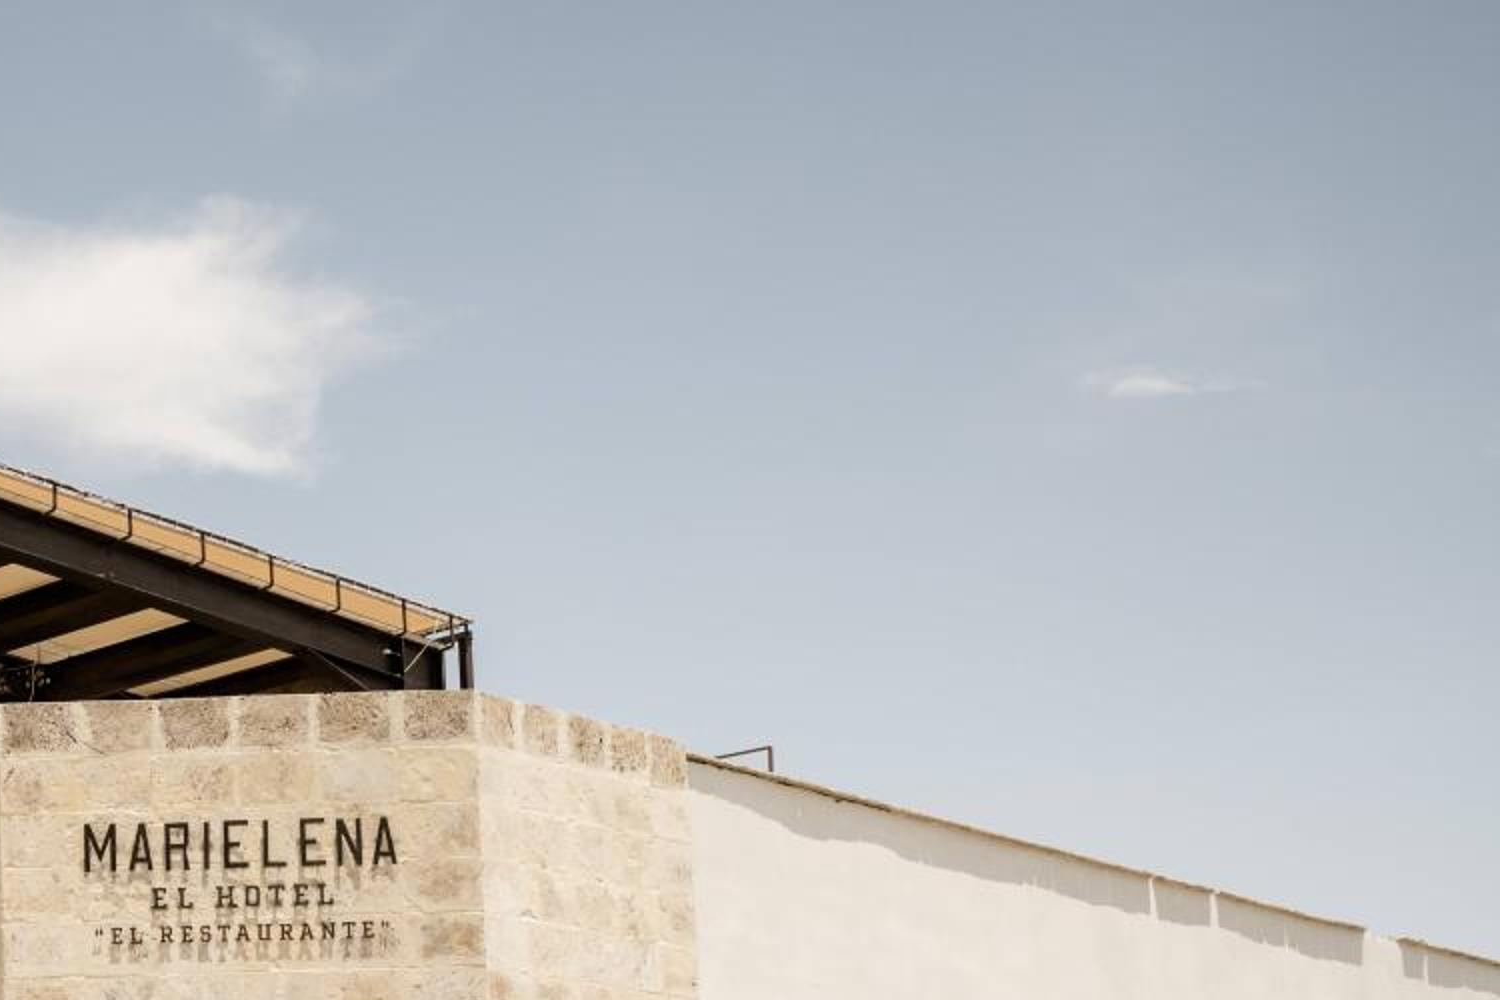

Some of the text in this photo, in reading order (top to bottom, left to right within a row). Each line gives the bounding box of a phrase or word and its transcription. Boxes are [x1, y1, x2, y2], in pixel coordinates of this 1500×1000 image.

[83, 816, 397, 872] MARIELENA
[151, 883, 335, 909] EL HOTEL
